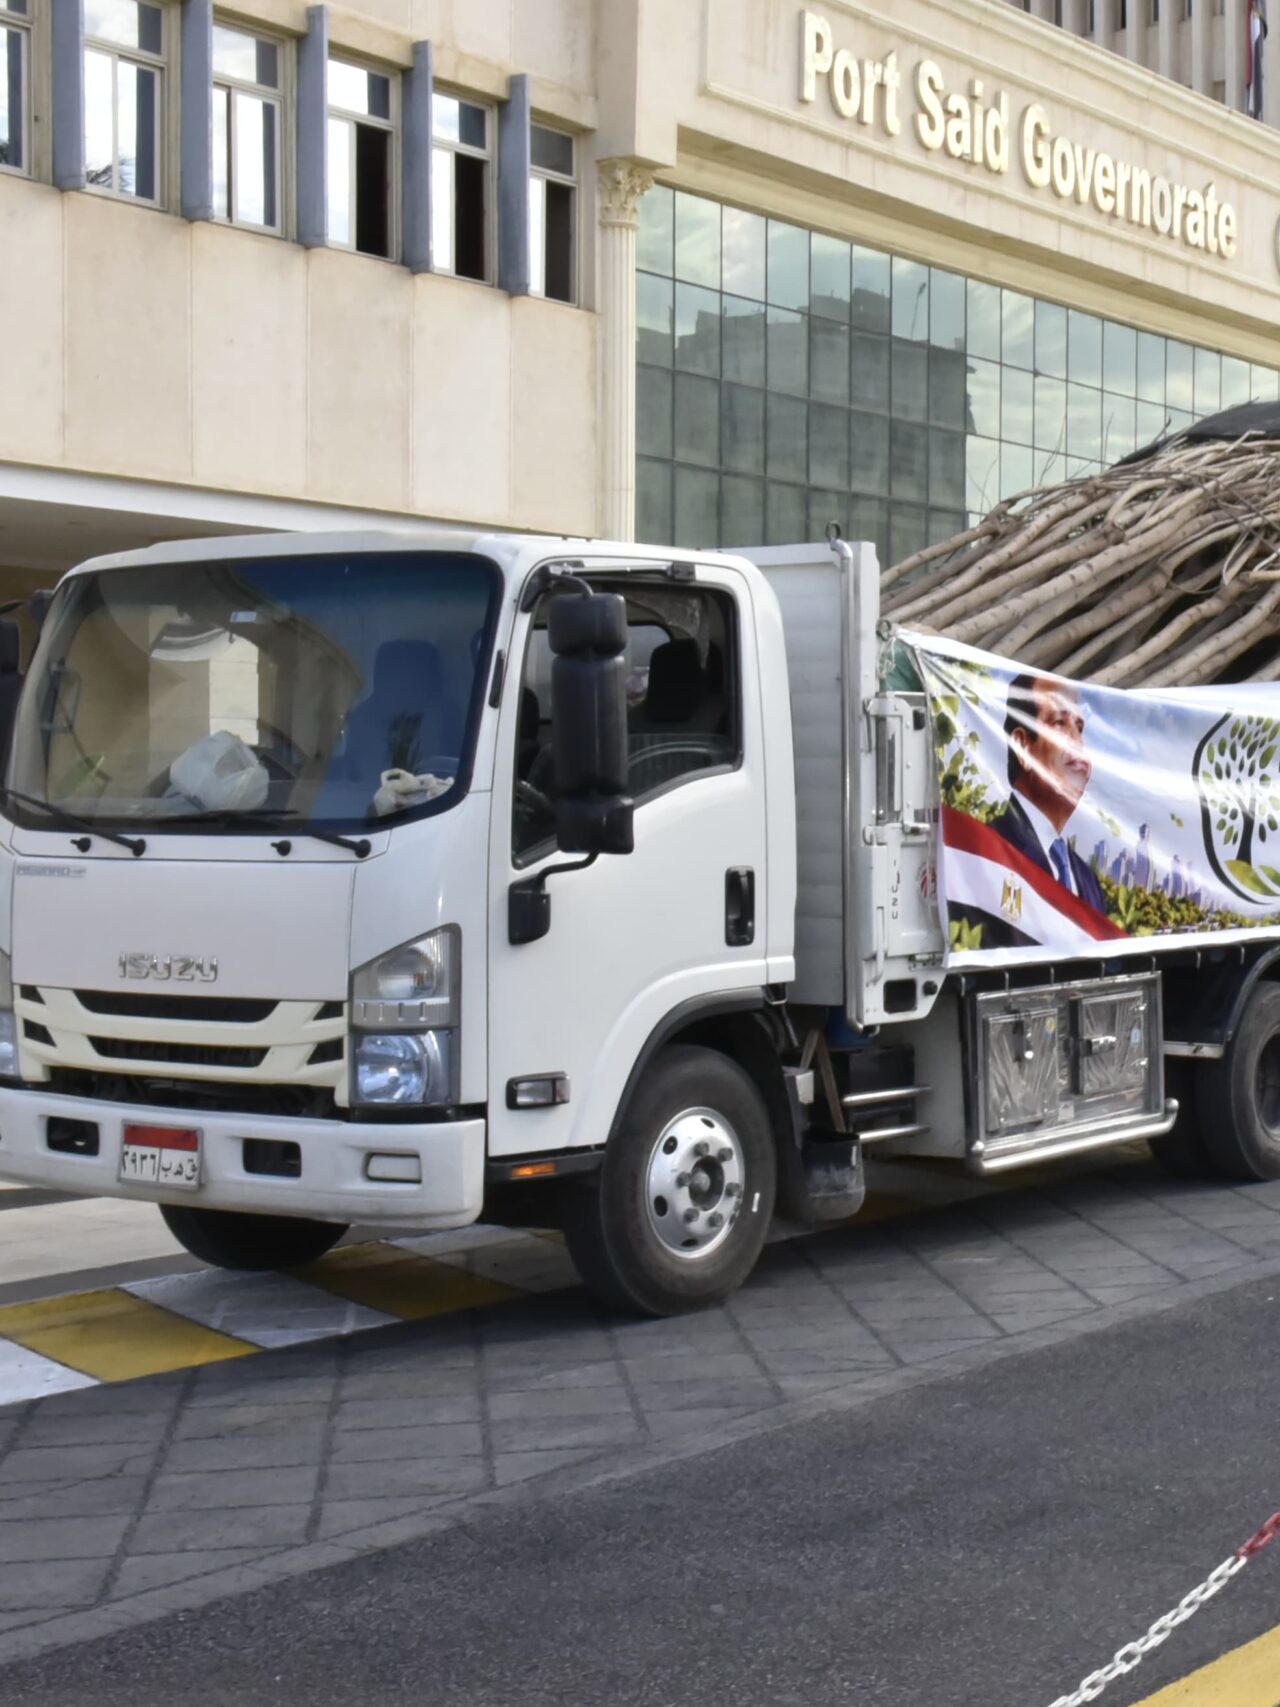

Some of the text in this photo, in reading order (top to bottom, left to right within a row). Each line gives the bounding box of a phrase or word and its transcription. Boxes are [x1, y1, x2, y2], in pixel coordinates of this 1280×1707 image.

[800, 9, 1238, 260] Port Said Governorate
[118, 952, 218, 982] ISUZU
